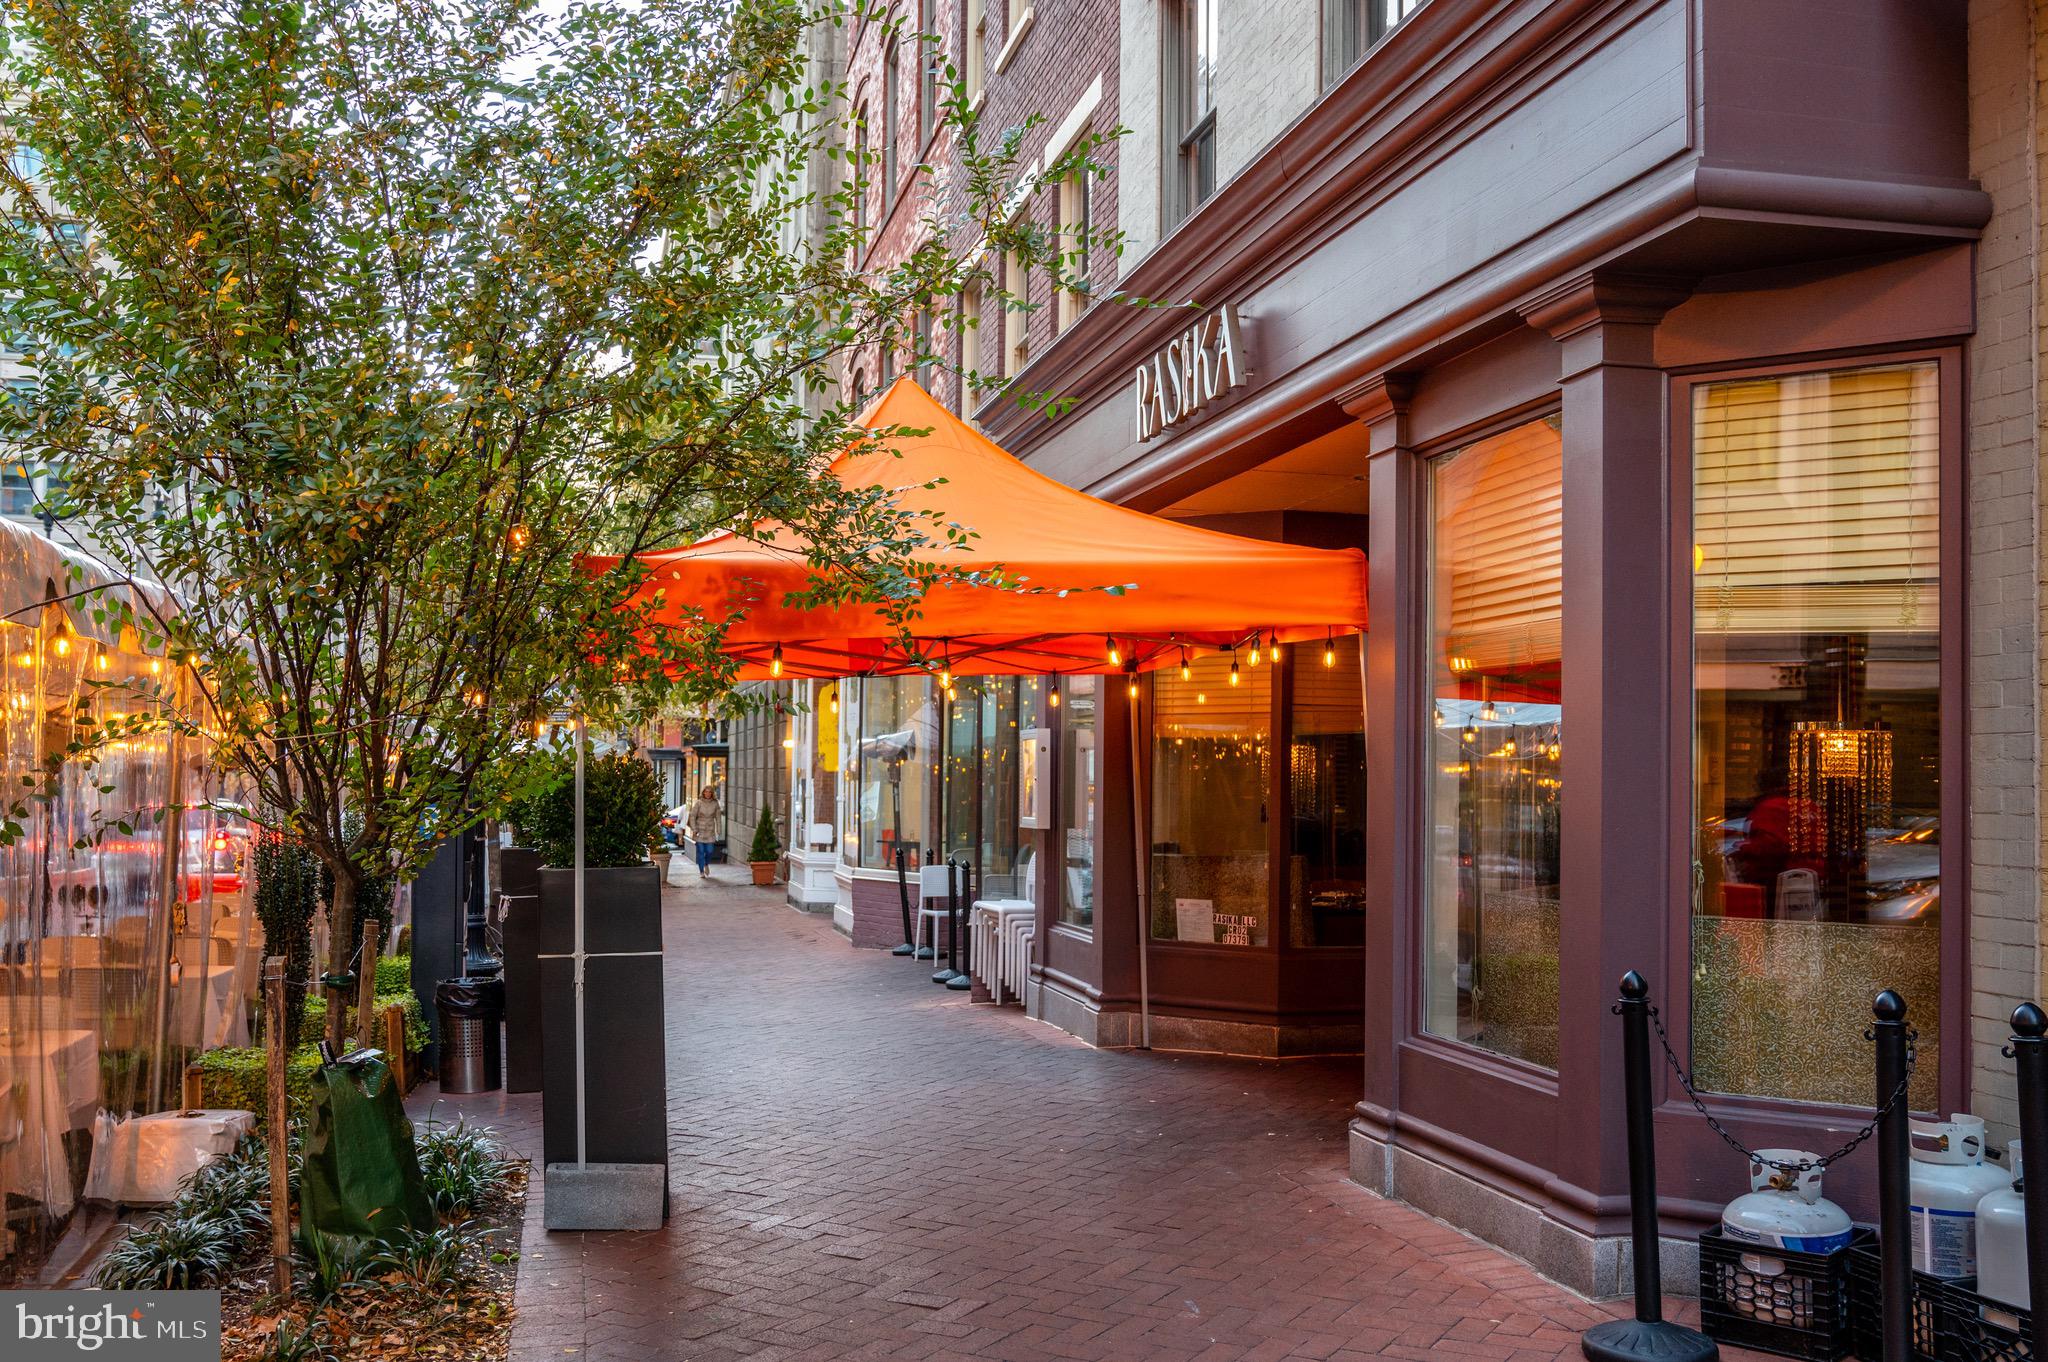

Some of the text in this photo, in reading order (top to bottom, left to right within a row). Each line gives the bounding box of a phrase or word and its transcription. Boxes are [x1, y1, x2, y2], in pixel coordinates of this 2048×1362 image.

[1136, 304, 1241, 442] RASIKA
[1212, 914, 1256, 926] RASIKA LLC
